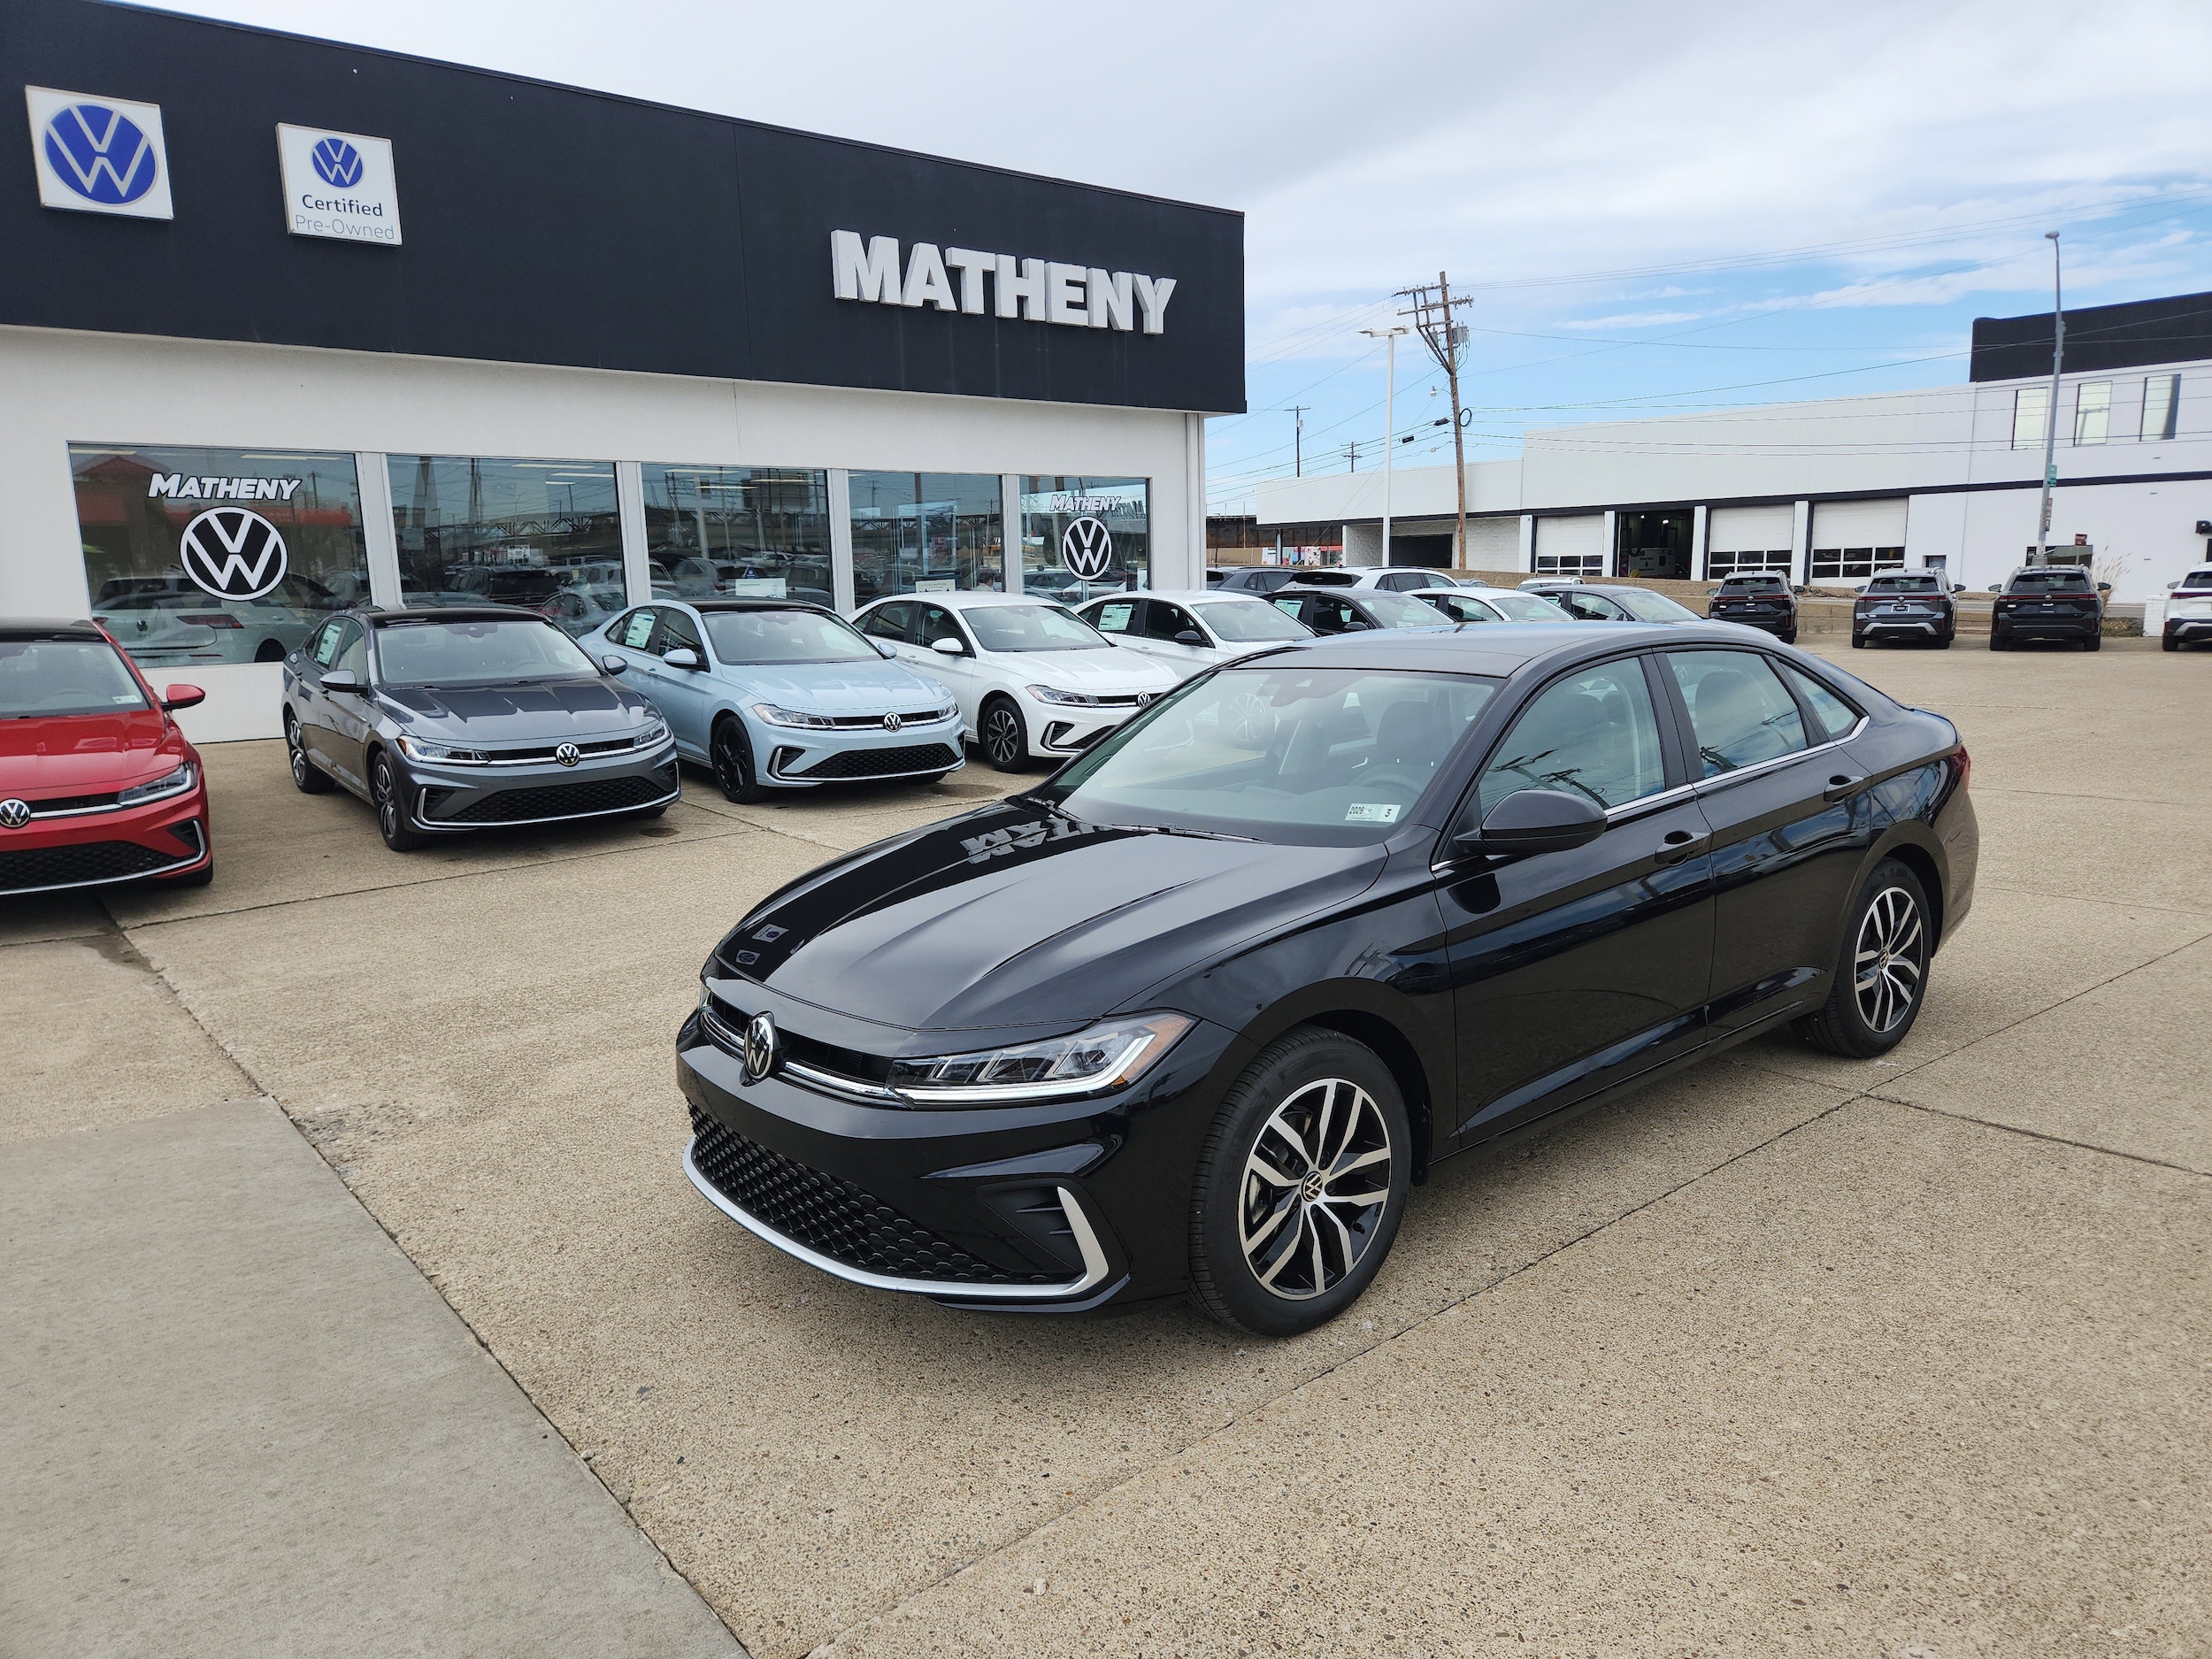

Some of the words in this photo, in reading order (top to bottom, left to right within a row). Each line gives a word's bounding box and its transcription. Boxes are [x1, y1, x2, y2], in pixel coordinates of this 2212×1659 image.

[43, 104, 157, 204] VW
[295, 214, 395, 240] Pre-Owned
[302, 194, 383, 218] Certified
[831, 229, 1178, 334] MATHENY
[149, 473, 302, 500] MATHENY
[1049, 495, 1121, 512] MATHENY
[181, 507, 288, 600] VW
[1064, 516, 1111, 580] VW
